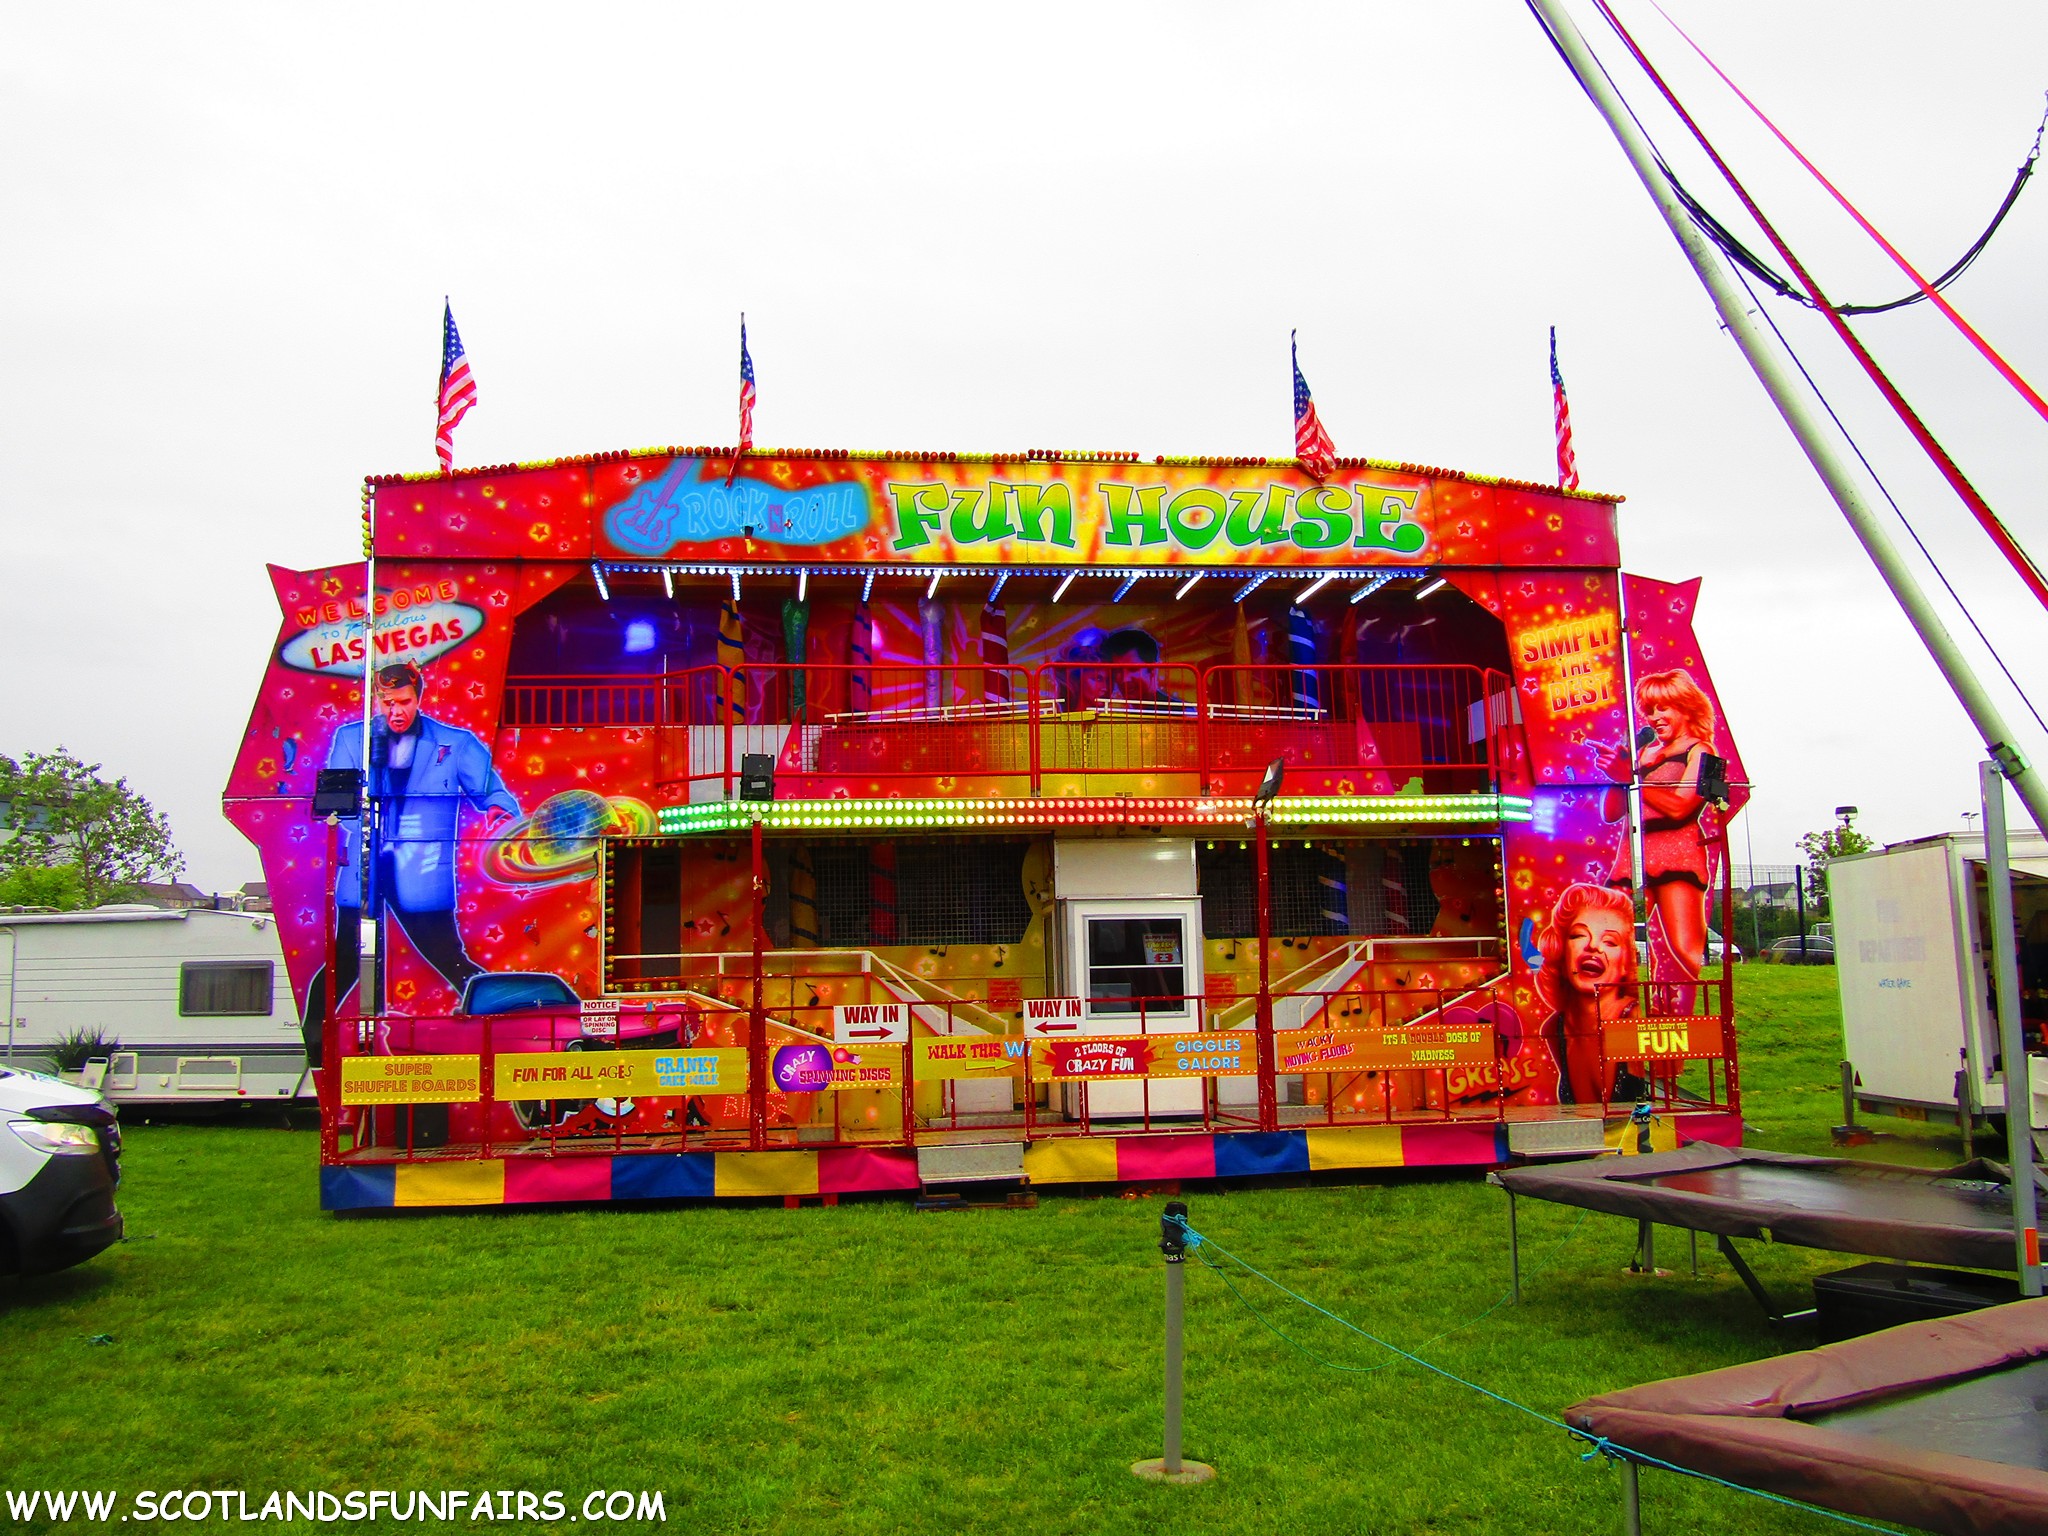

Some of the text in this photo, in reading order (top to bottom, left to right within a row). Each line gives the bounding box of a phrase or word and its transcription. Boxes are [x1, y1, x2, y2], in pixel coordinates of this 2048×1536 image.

[682, 486, 857, 540] ROCK N ROLL
[889, 481, 1425, 553] FUN HOUSE
[298, 580, 455, 625] WELCOME
[321, 629, 340, 640] TO
[1520, 613, 1613, 664] SIMPLY
[310, 639, 366, 669] LAS
[372, 618, 464, 656] VEGAS
[1556, 652, 1592, 678] THE
[1548, 672, 1610, 713] BEST
[584, 1001, 617, 1009] NOTICE
[1028, 1000, 1081, 1018] WAY IN
[843, 1005, 898, 1024] WAY IN
[1175, 1040, 1241, 1053] GIGGLES
[1297, 1034, 1335, 1049] WACKY
[1400, 1034, 1407, 1044] A
[1409, 1032, 1444, 1044] DOUBLE
[1446, 1032, 1467, 1043] DOSE
[1470, 1032, 1481, 1042] OF
[1637, 1030, 1689, 1053] FUN
[928, 1045, 966, 1060] WALK
[970, 1043, 1002, 1058] THIS
[1075, 1044, 1127, 1057] 2 FLOORS OF
[1285, 1043, 1355, 1068] MOVING FLOORS
[1411, 1049, 1455, 1061] MADNESS
[385, 1063, 432, 1075] SUPER
[655, 1057, 718, 1074] CRANKY
[780, 1050, 815, 1081] CRAZY
[1066, 1058, 1135, 1072] CRAZY FUN
[1178, 1056, 1240, 1070] GALORE
[513, 1065, 634, 1082] FUN FOR ALL AGES
[799, 1068, 890, 1084] SPINNING DISCS
[345, 1079, 477, 1093] SHUFFLE BOARDS
